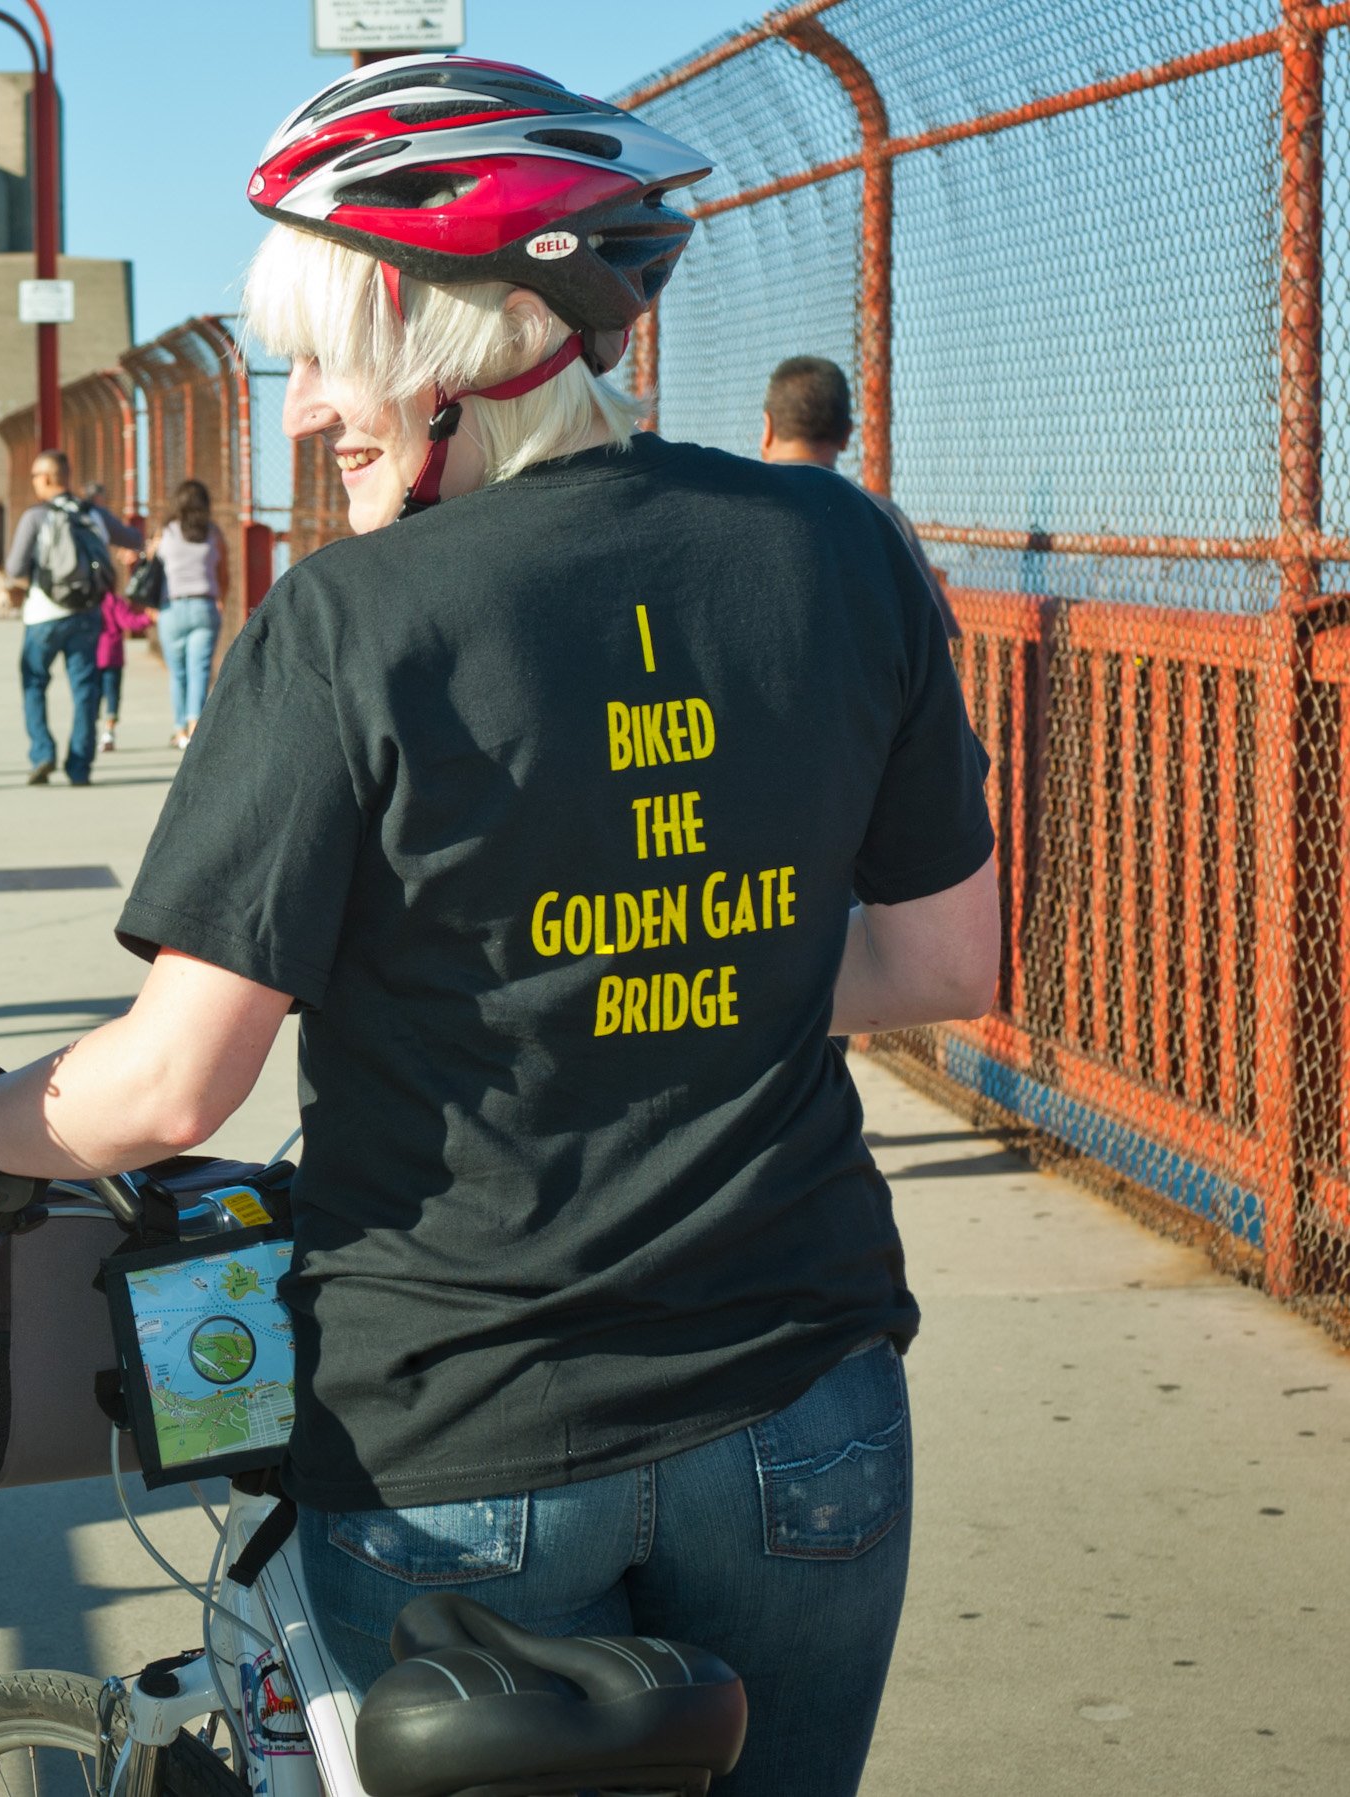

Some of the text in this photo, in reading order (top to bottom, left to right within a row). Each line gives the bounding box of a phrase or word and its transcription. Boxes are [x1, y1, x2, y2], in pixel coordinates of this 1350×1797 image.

[536, 238, 571, 254] BELL
[636, 604, 656, 673] I
[607, 697, 716, 771] BIKED
[631, 790, 706, 860] THE
[531, 865, 796, 957] GOLDEN GATE
[593, 965, 739, 1037] BRIDGE
